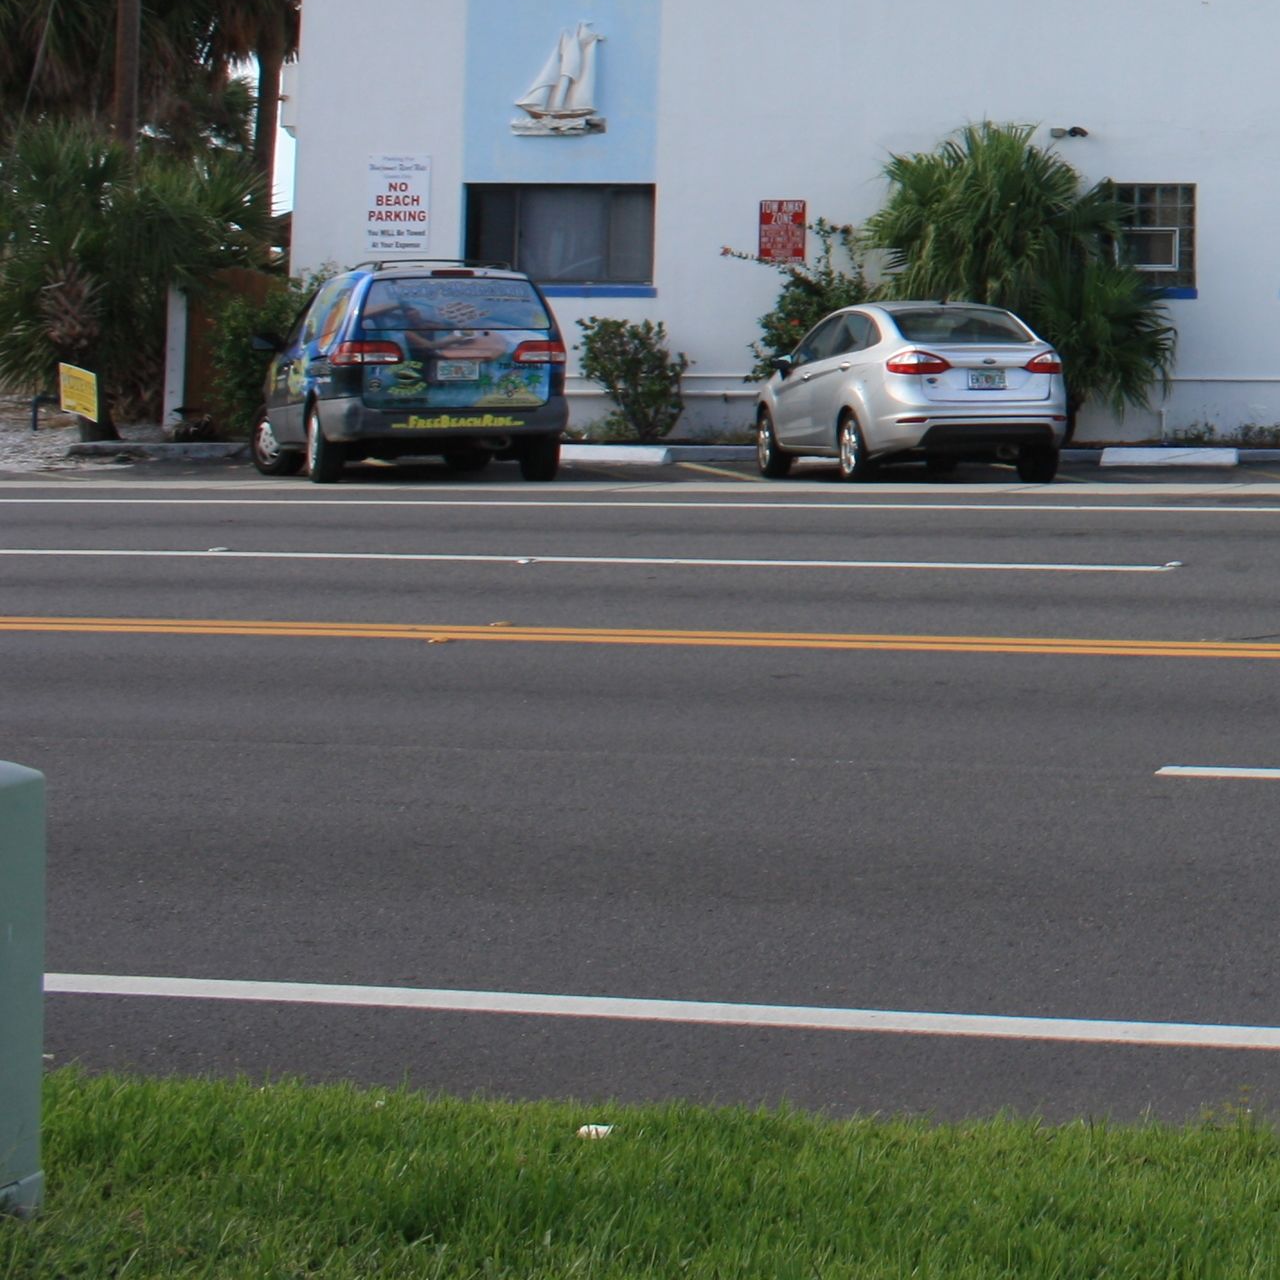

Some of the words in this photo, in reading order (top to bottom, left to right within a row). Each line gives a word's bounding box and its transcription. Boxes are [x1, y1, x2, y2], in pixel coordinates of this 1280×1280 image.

[388, 182, 408, 192] NO
[376, 195, 420, 206] BEACH
[368, 211, 426, 222] PARKING
